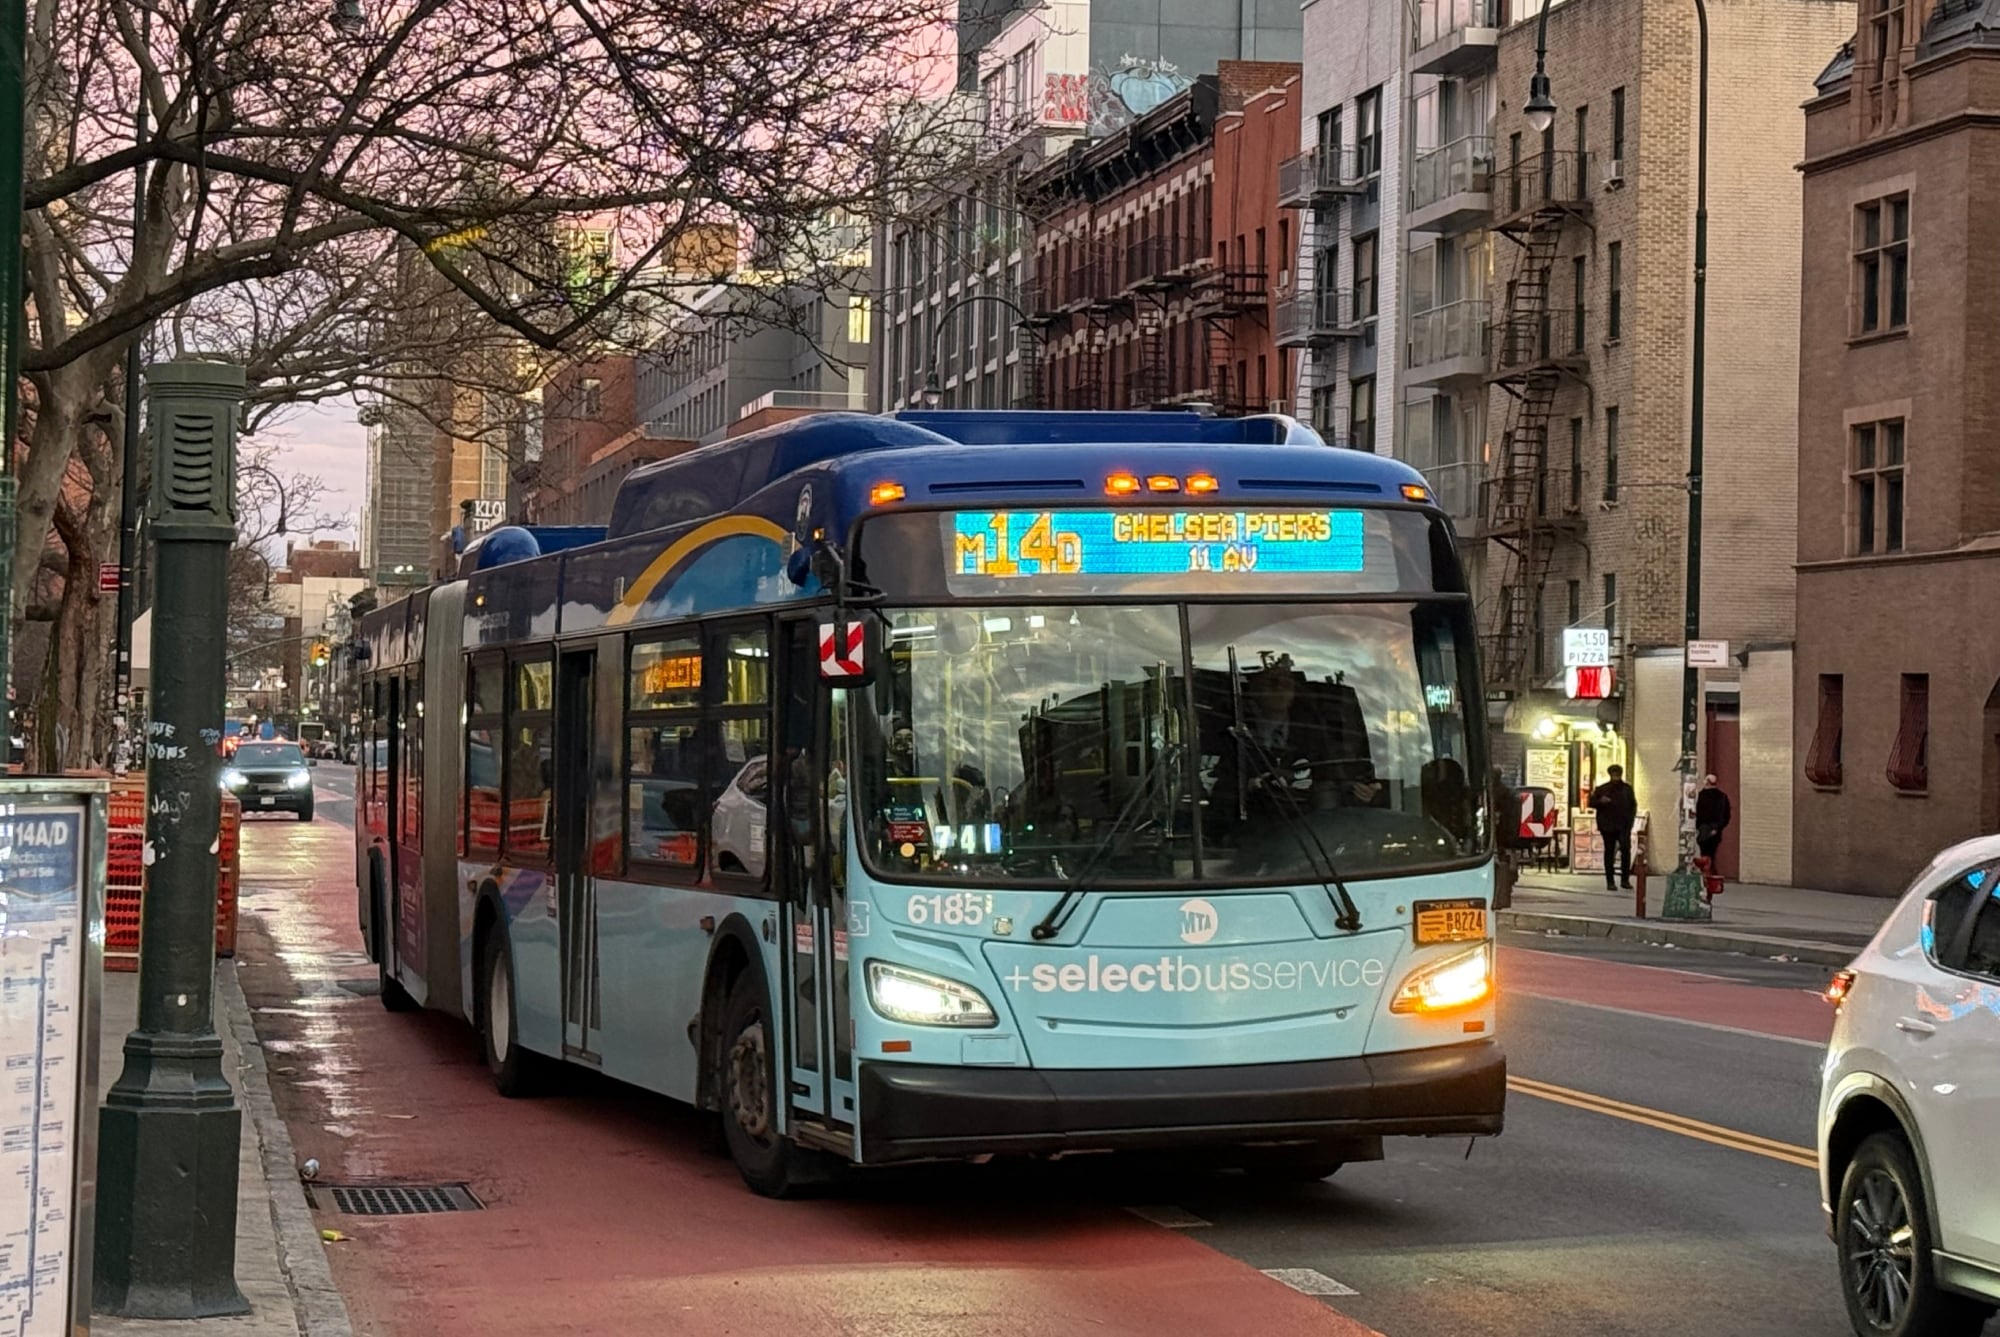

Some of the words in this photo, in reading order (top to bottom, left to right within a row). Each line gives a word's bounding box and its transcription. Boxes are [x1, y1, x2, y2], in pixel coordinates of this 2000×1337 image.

[1114, 513, 1237, 542] CHELSEA
[1246, 513, 1331, 542] PIERS
[956, 513, 1082, 575] M14D
[1188, 546, 1211, 571] 11
[1223, 546, 1257, 571] AV
[1569, 652, 1606, 664] PIZZA
[151, 793, 181, 823] Jay
[907, 893, 984, 926] 6185
[1180, 909, 1212, 935] MTA
